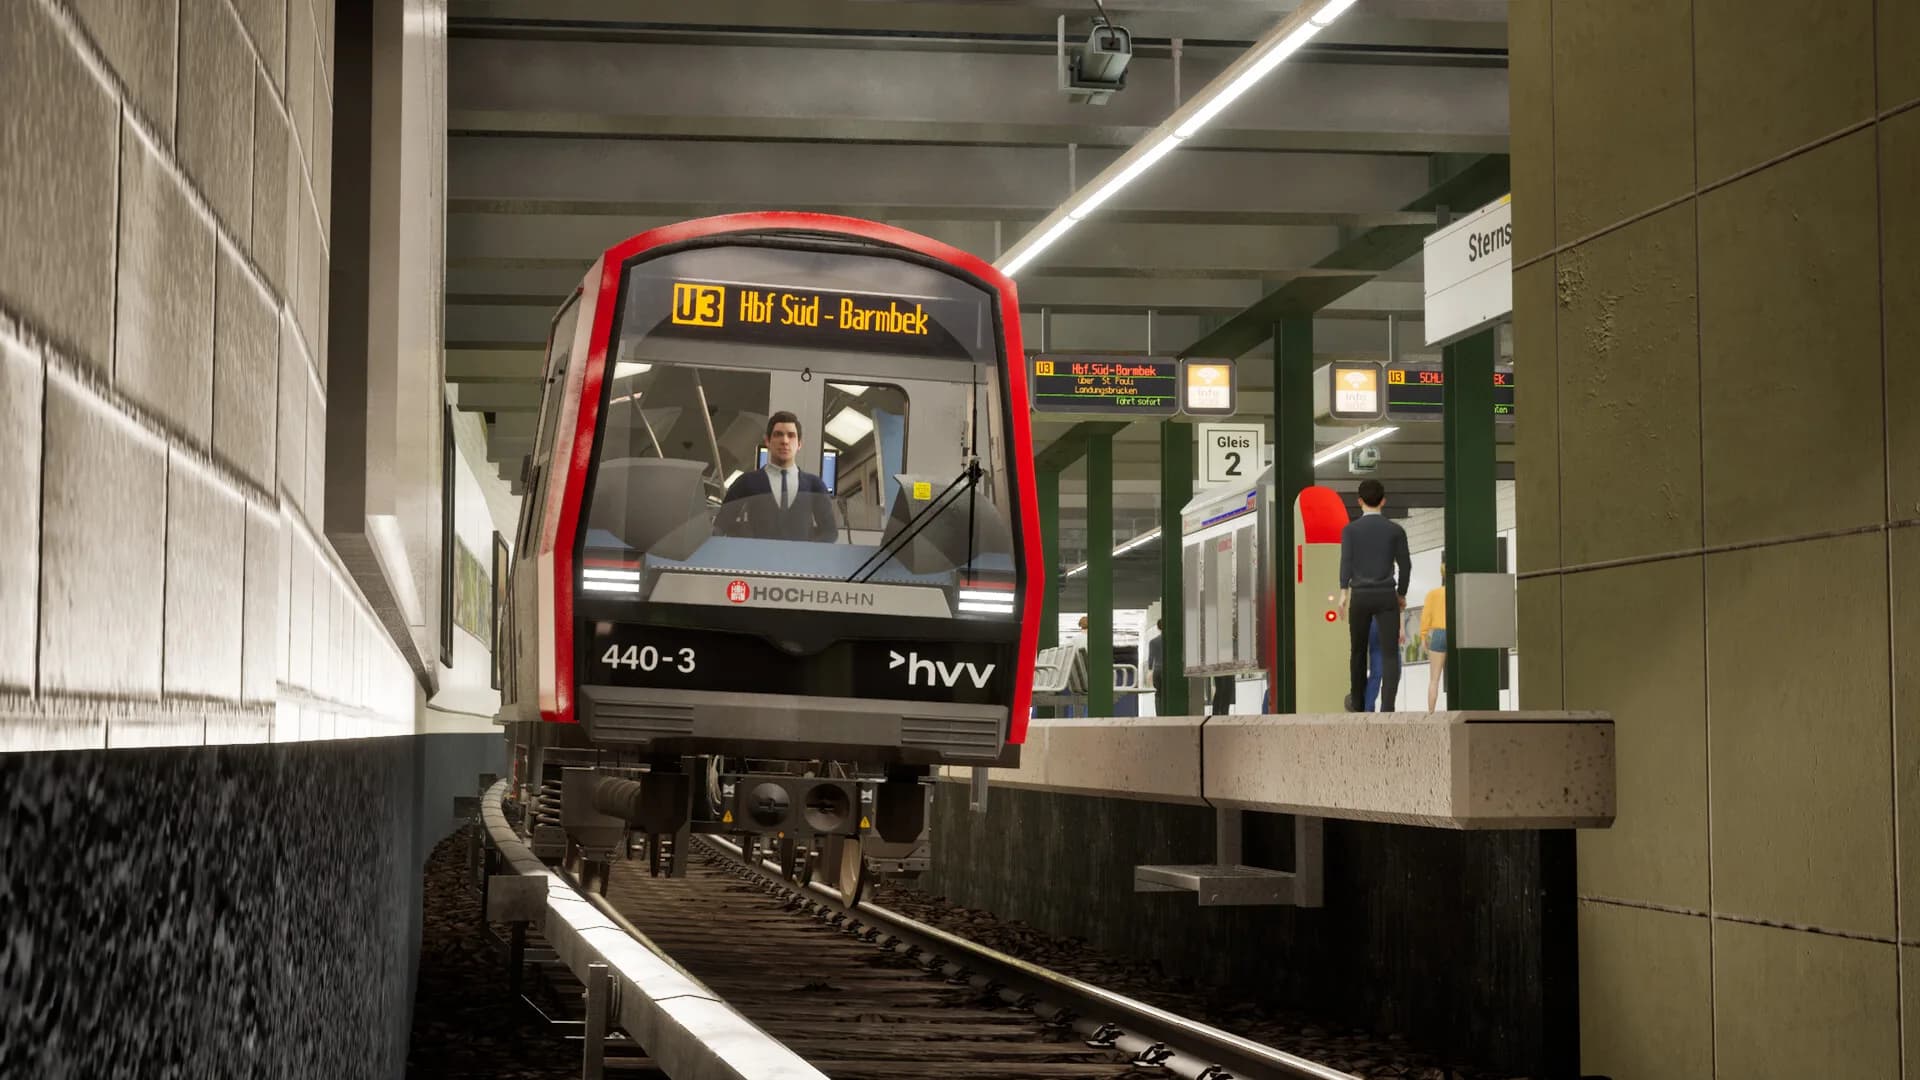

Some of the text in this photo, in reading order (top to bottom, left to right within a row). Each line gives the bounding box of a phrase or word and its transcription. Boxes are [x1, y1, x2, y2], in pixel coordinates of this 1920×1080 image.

[1468, 222, 1512, 262] Sterns
[675, 285, 723, 325] U3
[739, 290, 775, 323] Hbf
[781, 294, 819, 327] Süd
[840, 298, 928, 336] Barmbek
[1038, 361, 1052, 375] U3
[1390, 371, 1403, 383] U3
[1217, 436, 1250, 448] Gleis
[1224, 452, 1242, 476] 2
[753, 584, 874, 607] HOCHBAHN
[601, 644, 696, 674] 440-3
